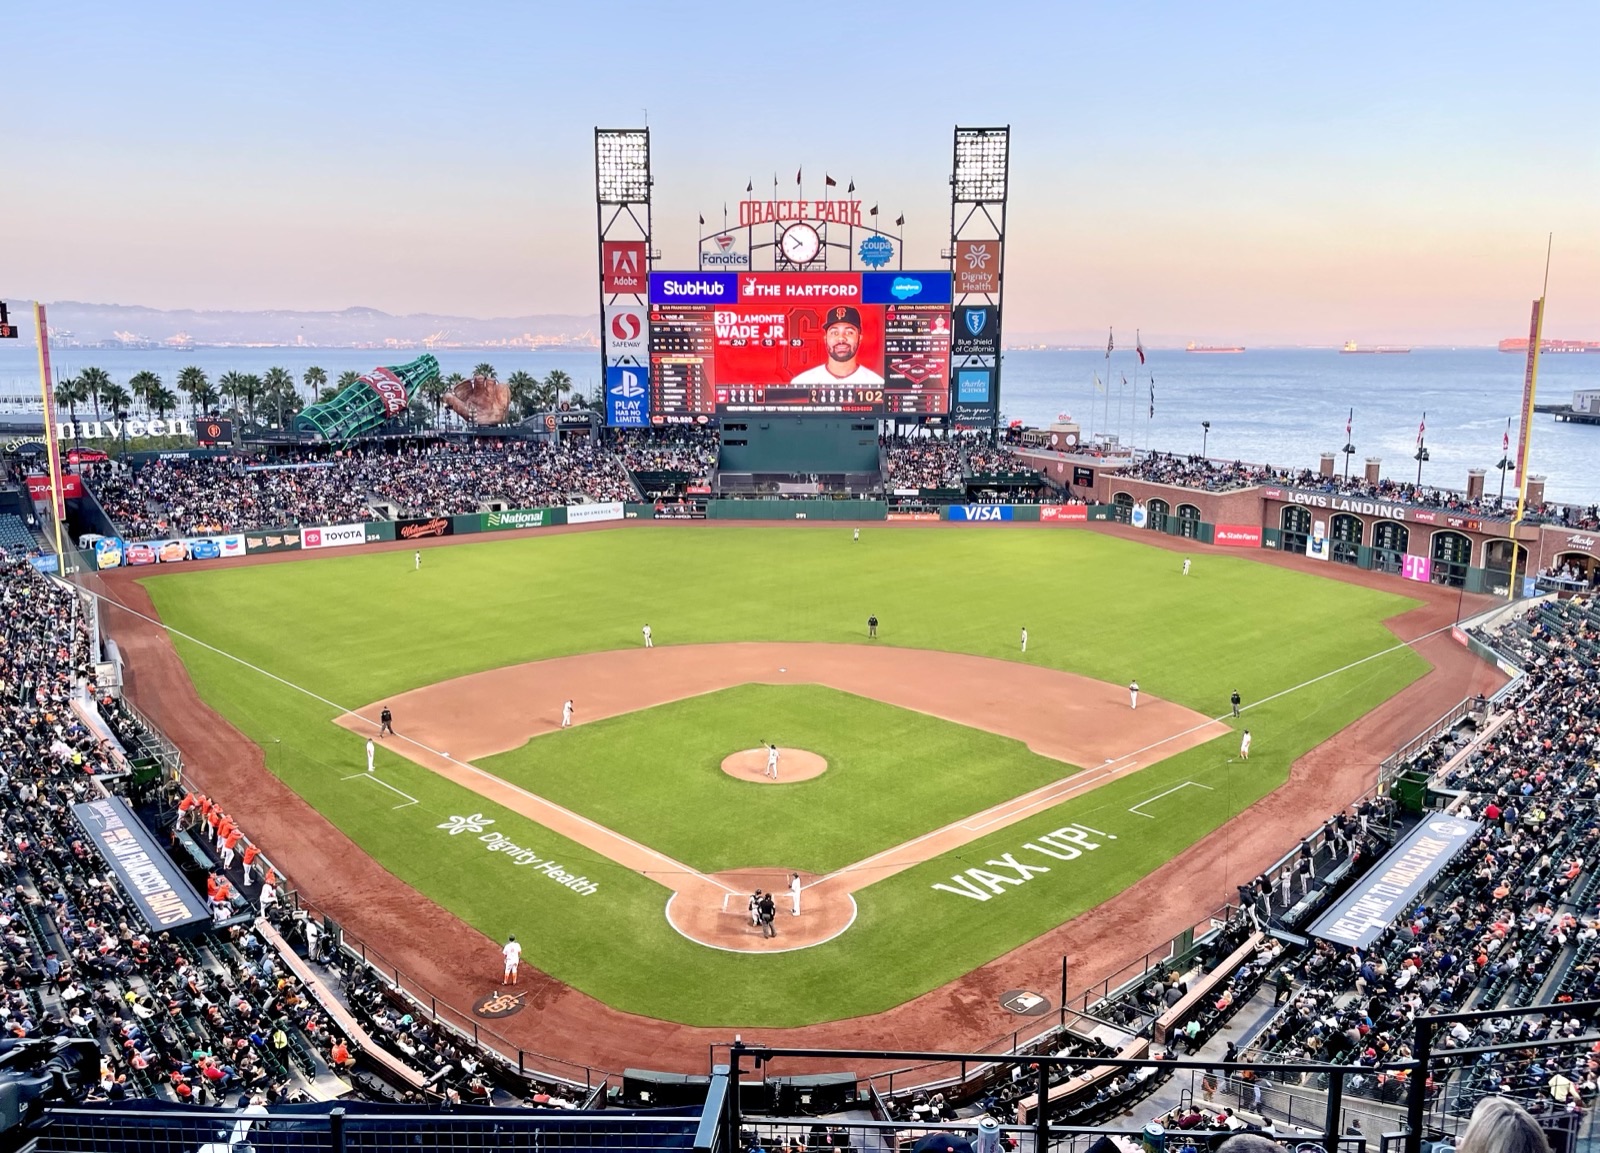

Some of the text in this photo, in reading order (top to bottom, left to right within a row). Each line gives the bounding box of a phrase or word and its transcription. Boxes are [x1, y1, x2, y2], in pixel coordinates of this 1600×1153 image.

[740, 200, 862, 226] ORACLE PARK
[863, 240, 890, 252] coupa
[702, 252, 748, 266] Fanatics
[614, 277, 637, 286] Adobe
[962, 273, 992, 283] Dignity
[664, 281, 724, 295] StubHub
[757, 285, 857, 296] THE HARTFORD
[718, 313, 784, 323] 31 LAMONTE
[716, 326, 759, 338] WADE
[764, 326, 784, 338] JR
[962, 379, 986, 388] charles
[616, 401, 640, 410] PLAY
[56, 418, 188, 439] nuveen
[30, 483, 74, 492] ORALE
[962, 506, 1002, 520] VISA
[1332, 499, 1404, 520] LANDING
[501, 511, 543, 524] National
[325, 530, 362, 540] TOYOTA
[1567, 535, 1594, 546] Alaska
[1494, 587, 1508, 596] 309
[107, 838, 144, 856] SAN
[478, 832, 599, 896] Dignity Health
[930, 823, 1117, 901] VAX UP!
[117, 851, 171, 895] FRANCISCO
[1325, 835, 1450, 942] WELCOME TO ORACLE PARK
[144, 890, 192, 924] GIANTS
